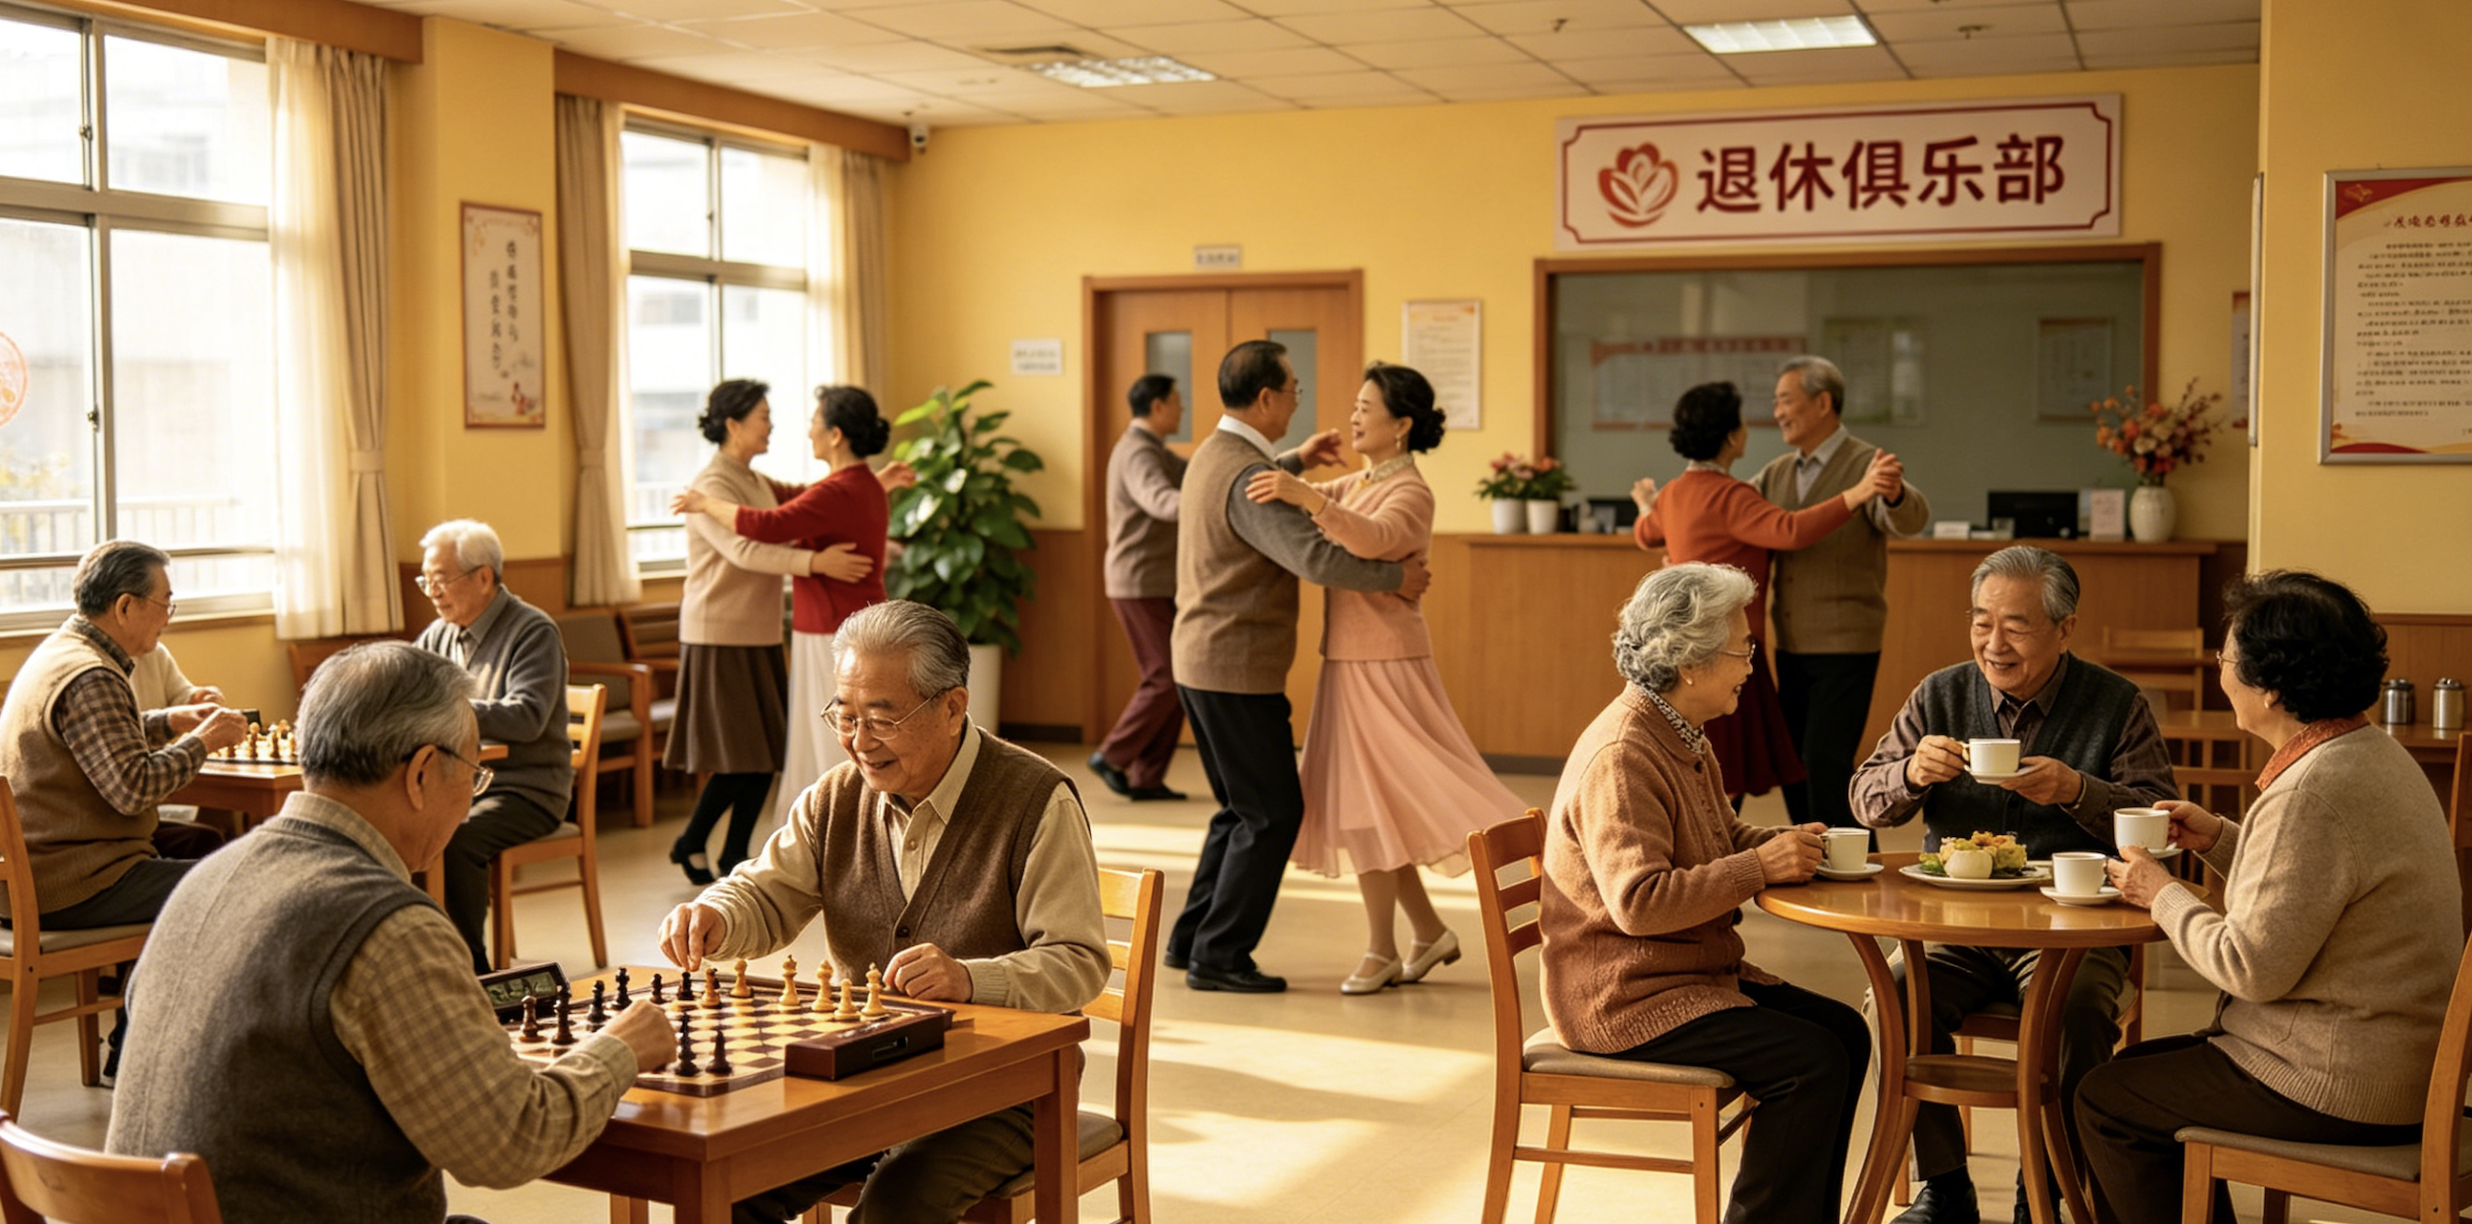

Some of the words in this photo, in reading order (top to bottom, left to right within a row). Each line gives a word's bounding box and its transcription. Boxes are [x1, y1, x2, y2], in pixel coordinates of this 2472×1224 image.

[1697, 132, 2065, 212] 退休俱乐部
